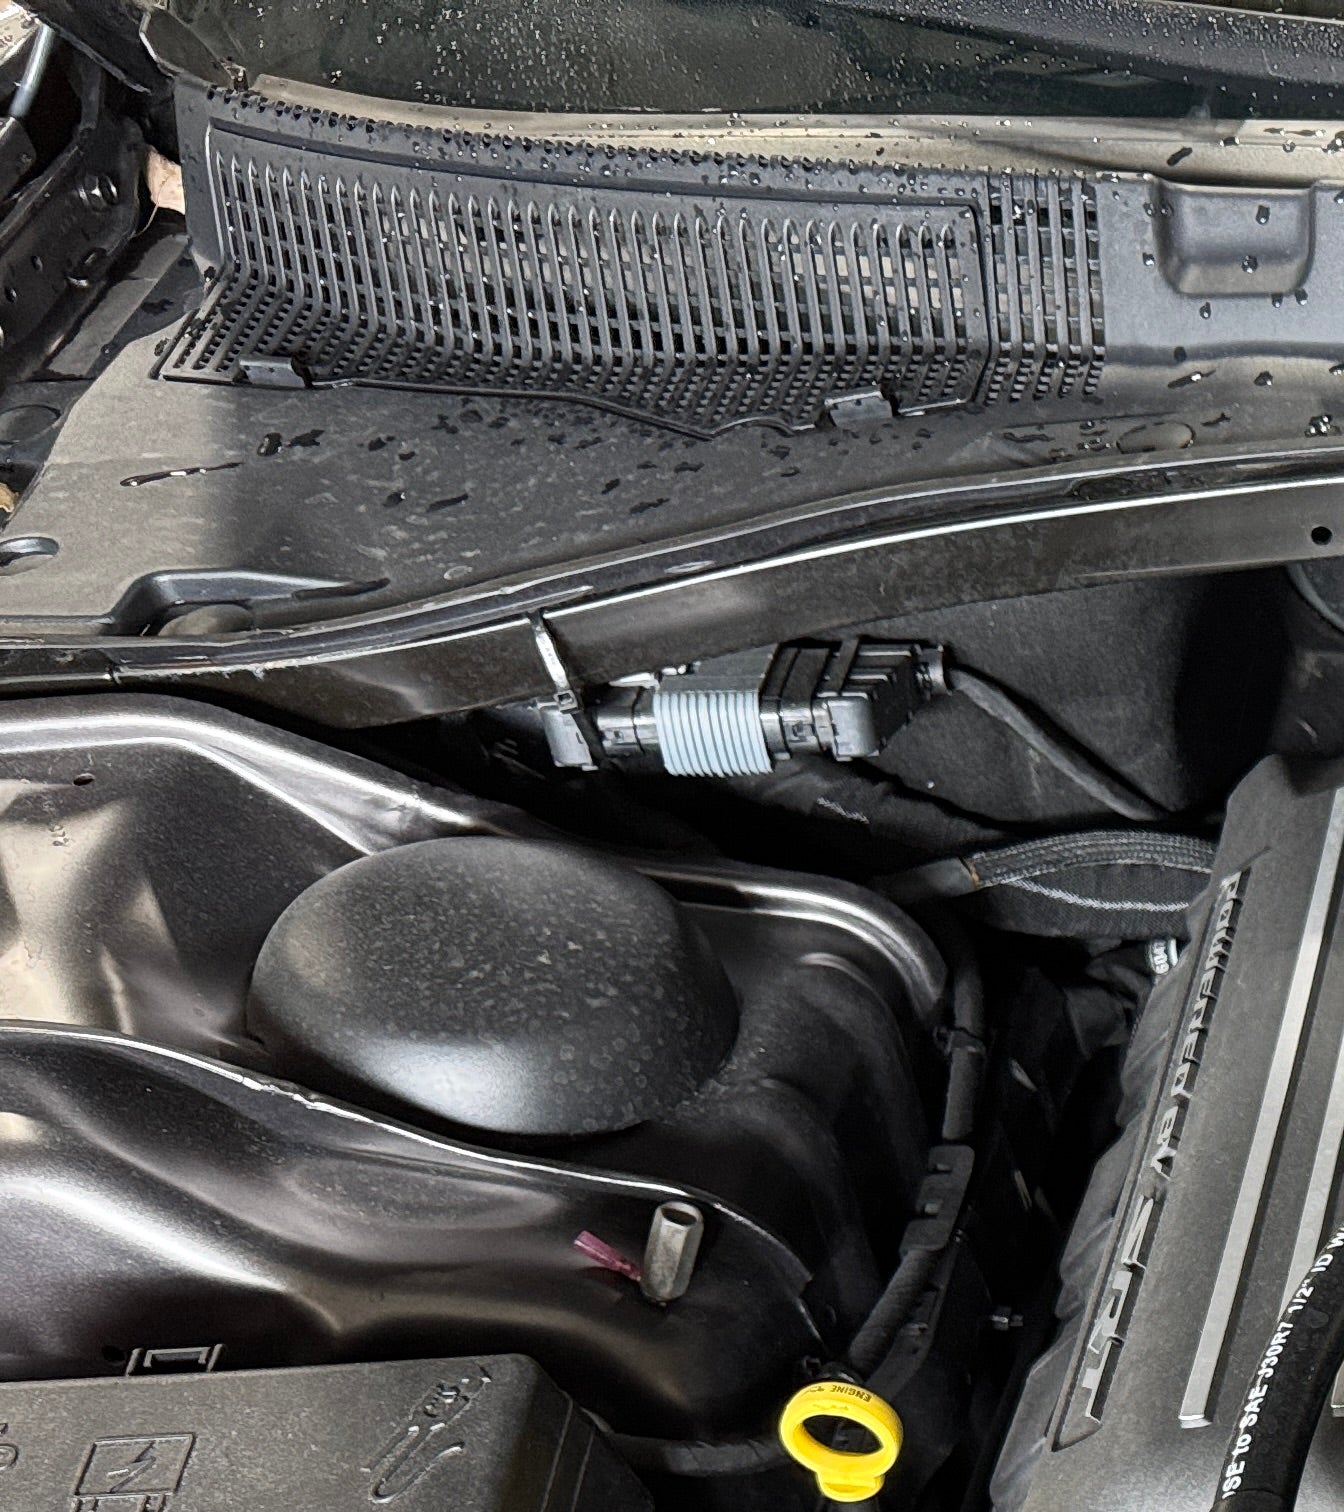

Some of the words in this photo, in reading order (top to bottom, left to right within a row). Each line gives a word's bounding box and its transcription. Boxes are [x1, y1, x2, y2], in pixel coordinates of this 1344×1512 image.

[1171, 869, 1243, 1100] POWERED
[1151, 1105, 1182, 1182] BY
[830, 1385, 872, 1403] ENGINE
[1083, 1194, 1154, 1424] SRT
[1240, 1384, 1268, 1430] SAE
[1258, 1321, 1293, 1378] J30R7
[1311, 1253, 1333, 1273] ID
